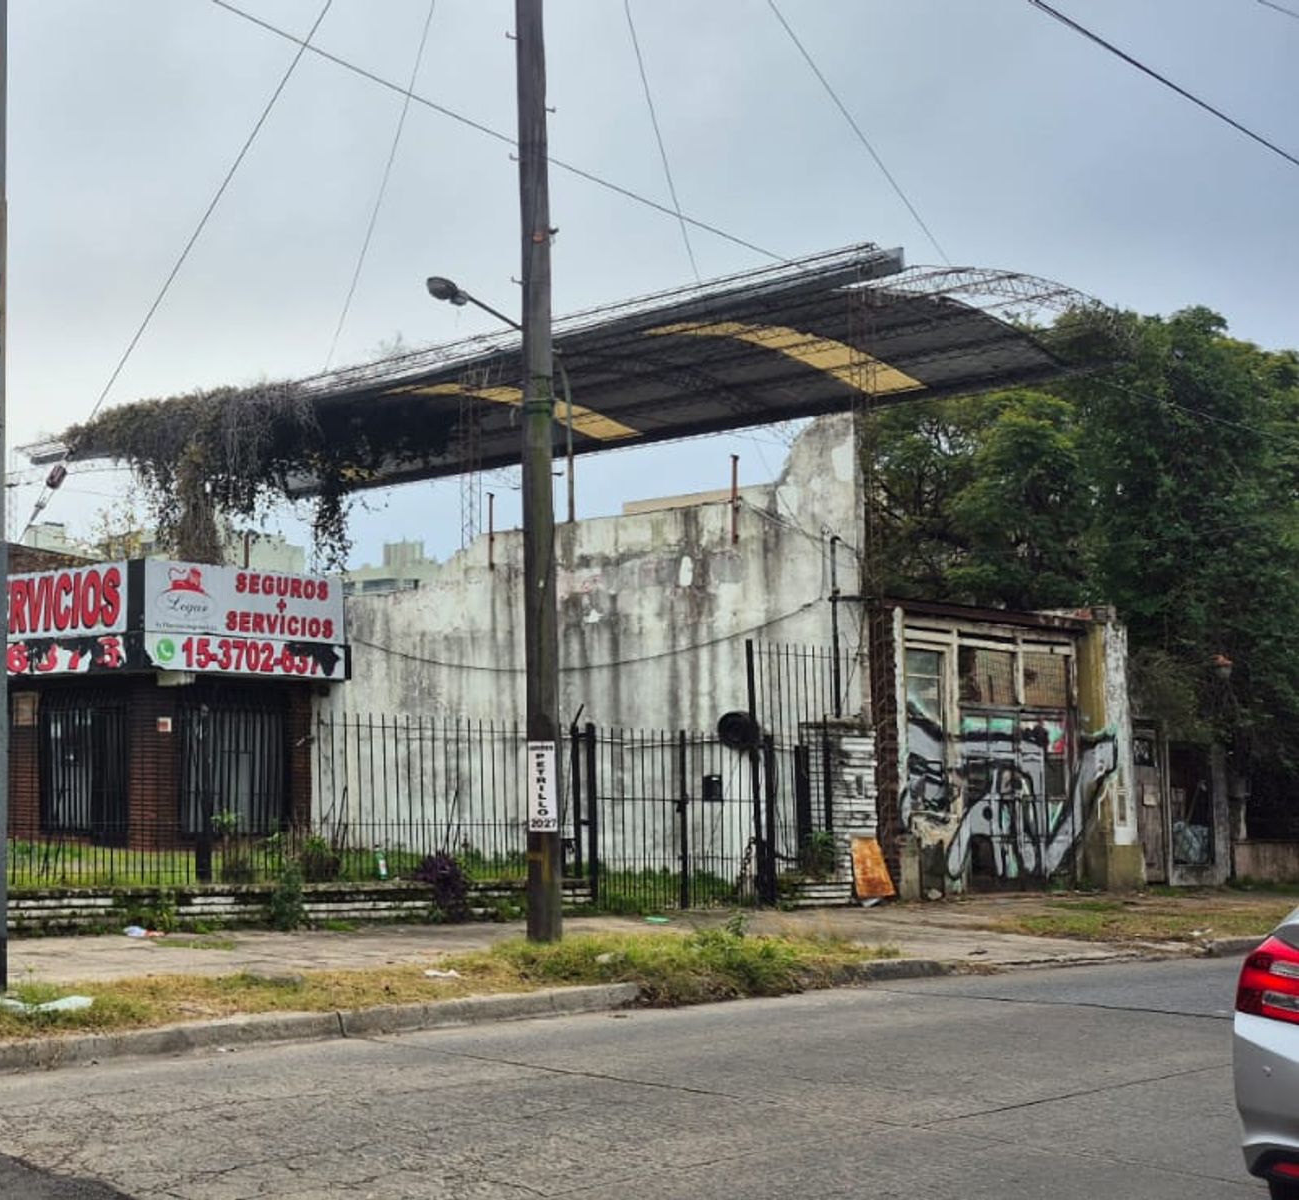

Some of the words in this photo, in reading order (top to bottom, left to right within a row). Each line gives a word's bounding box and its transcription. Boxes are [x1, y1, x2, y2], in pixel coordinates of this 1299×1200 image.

[236, 572, 329, 601] SEGUROS
[225, 610, 334, 639] SERVICIOS
[535, 753, 549, 816] PETRILLO
[531, 818, 557, 828] 2027
